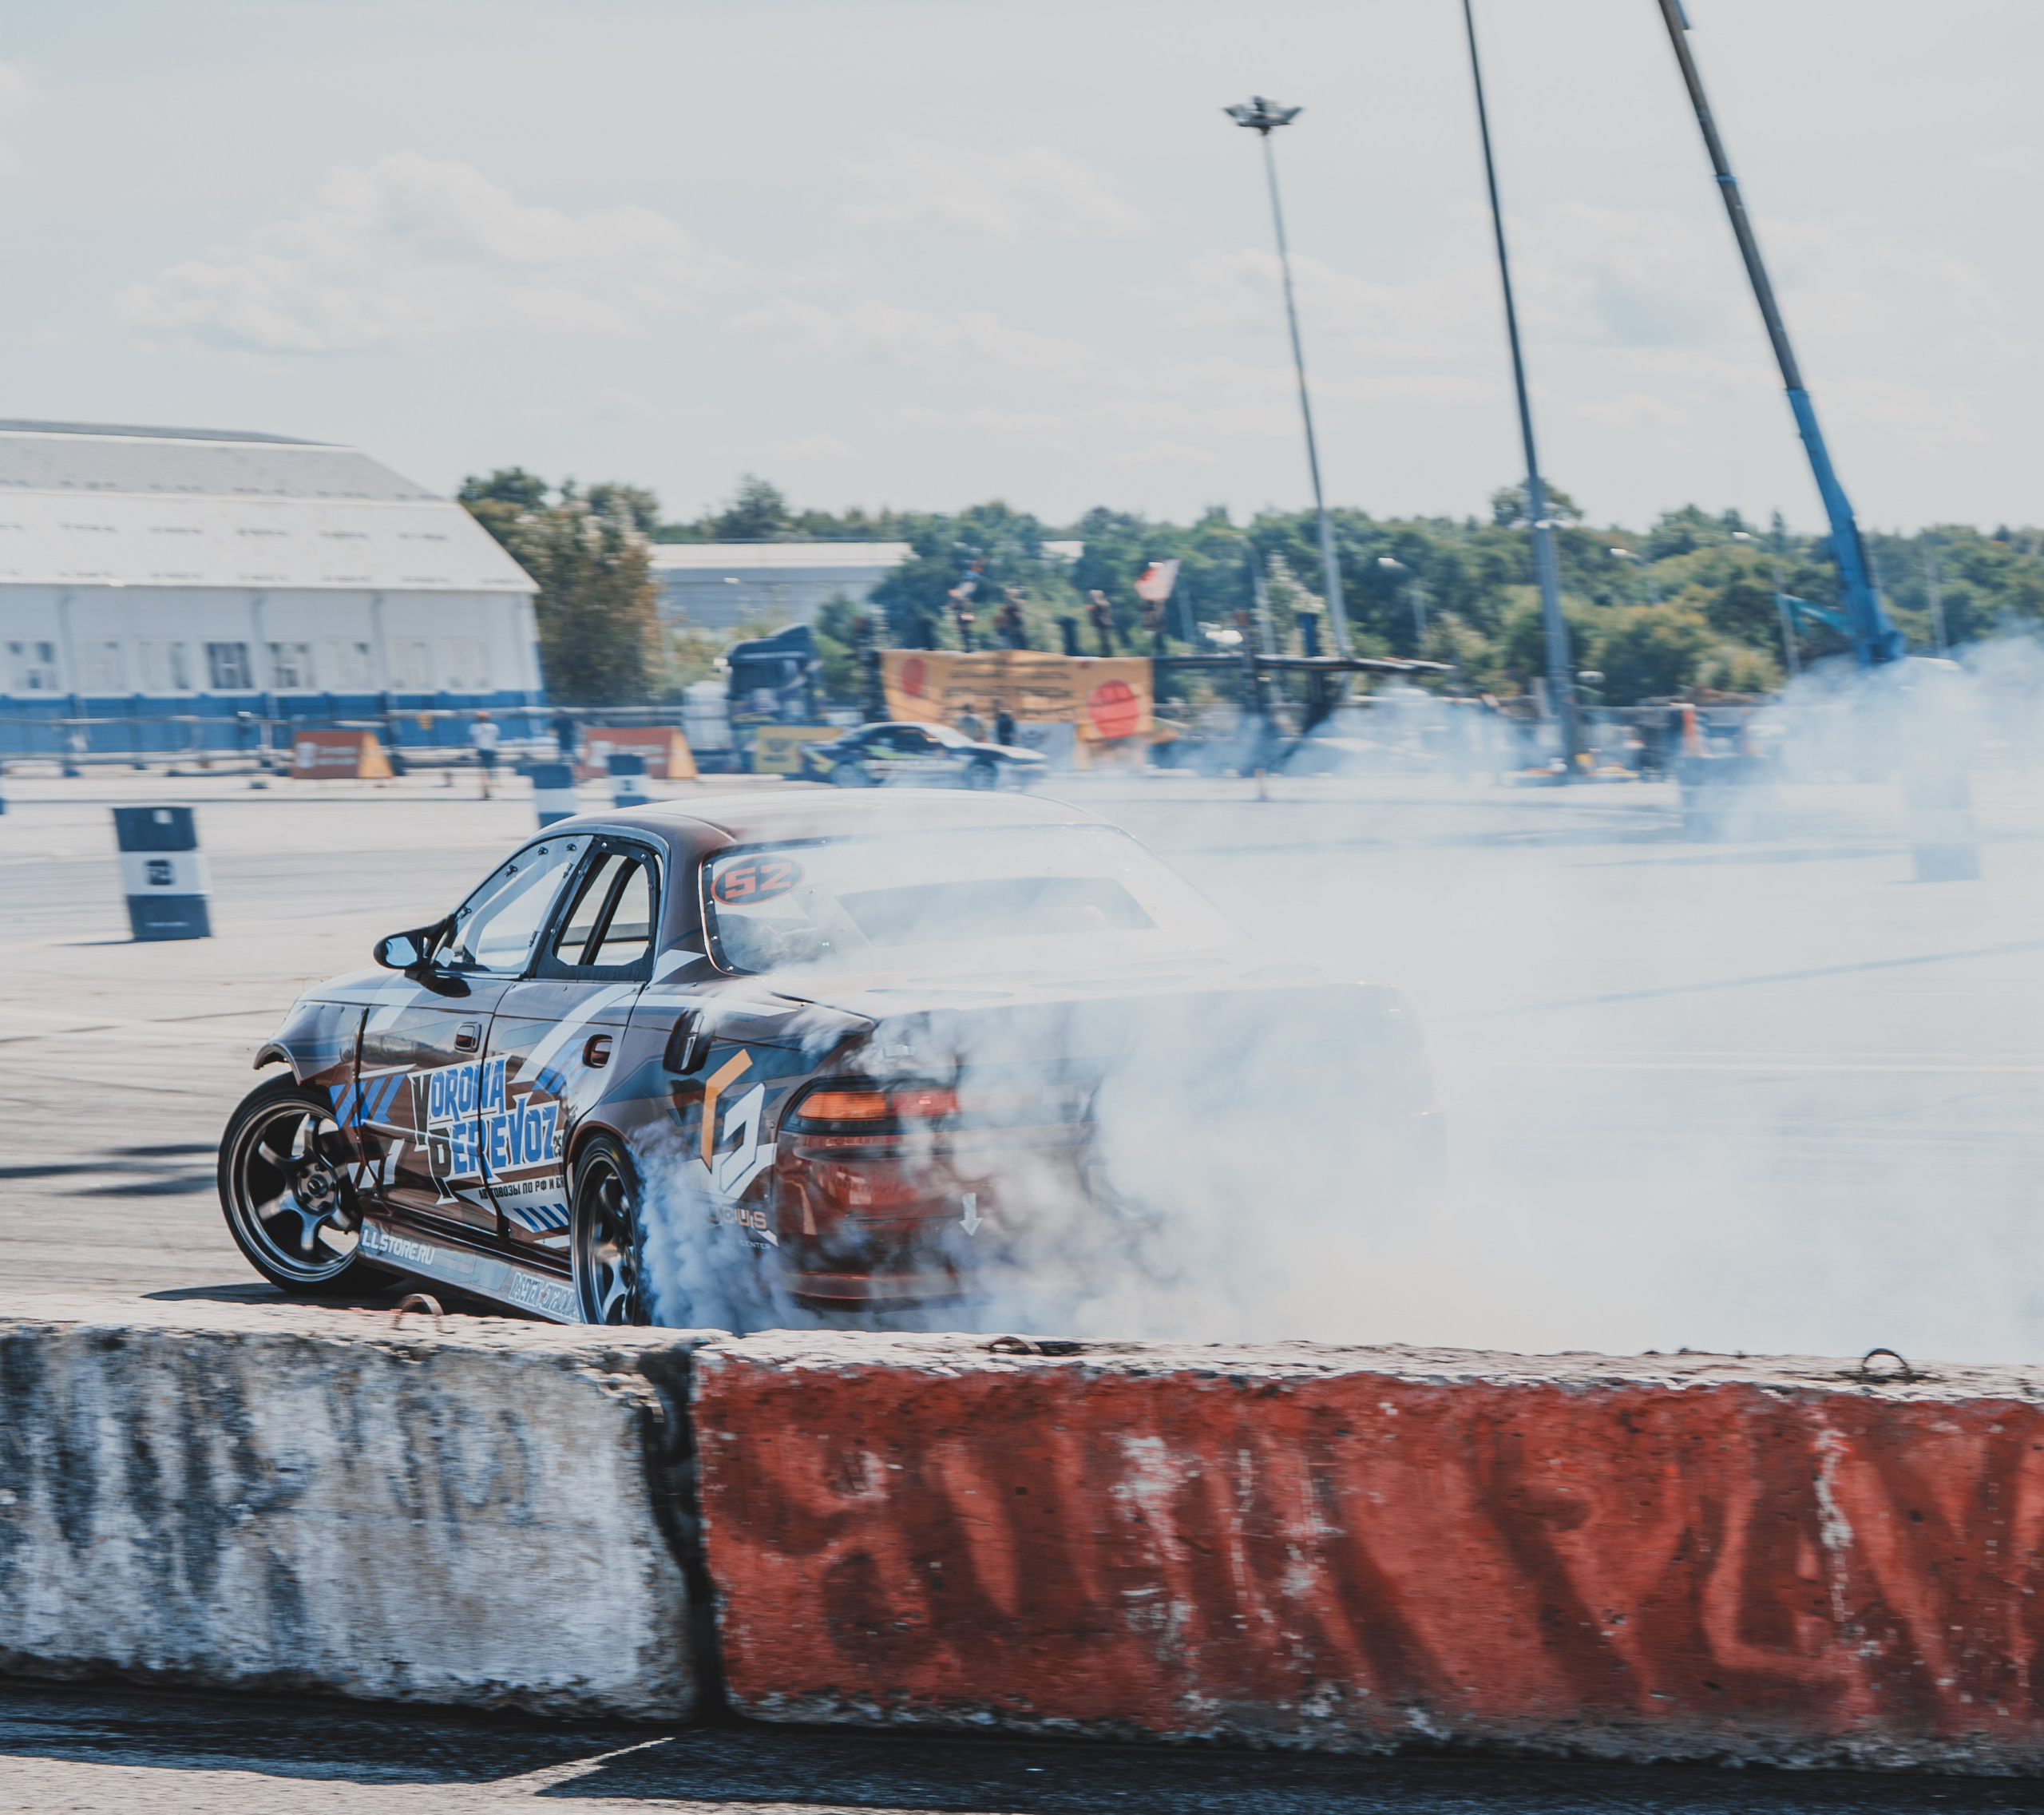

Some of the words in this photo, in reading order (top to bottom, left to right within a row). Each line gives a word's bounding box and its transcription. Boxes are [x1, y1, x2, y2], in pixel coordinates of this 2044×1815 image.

[725, 862, 792, 900] 52
[410, 1059, 507, 1147] VORONA
[428, 1097, 558, 1199] PEREVOZ
[523, 1181, 533, 1195] ПО
